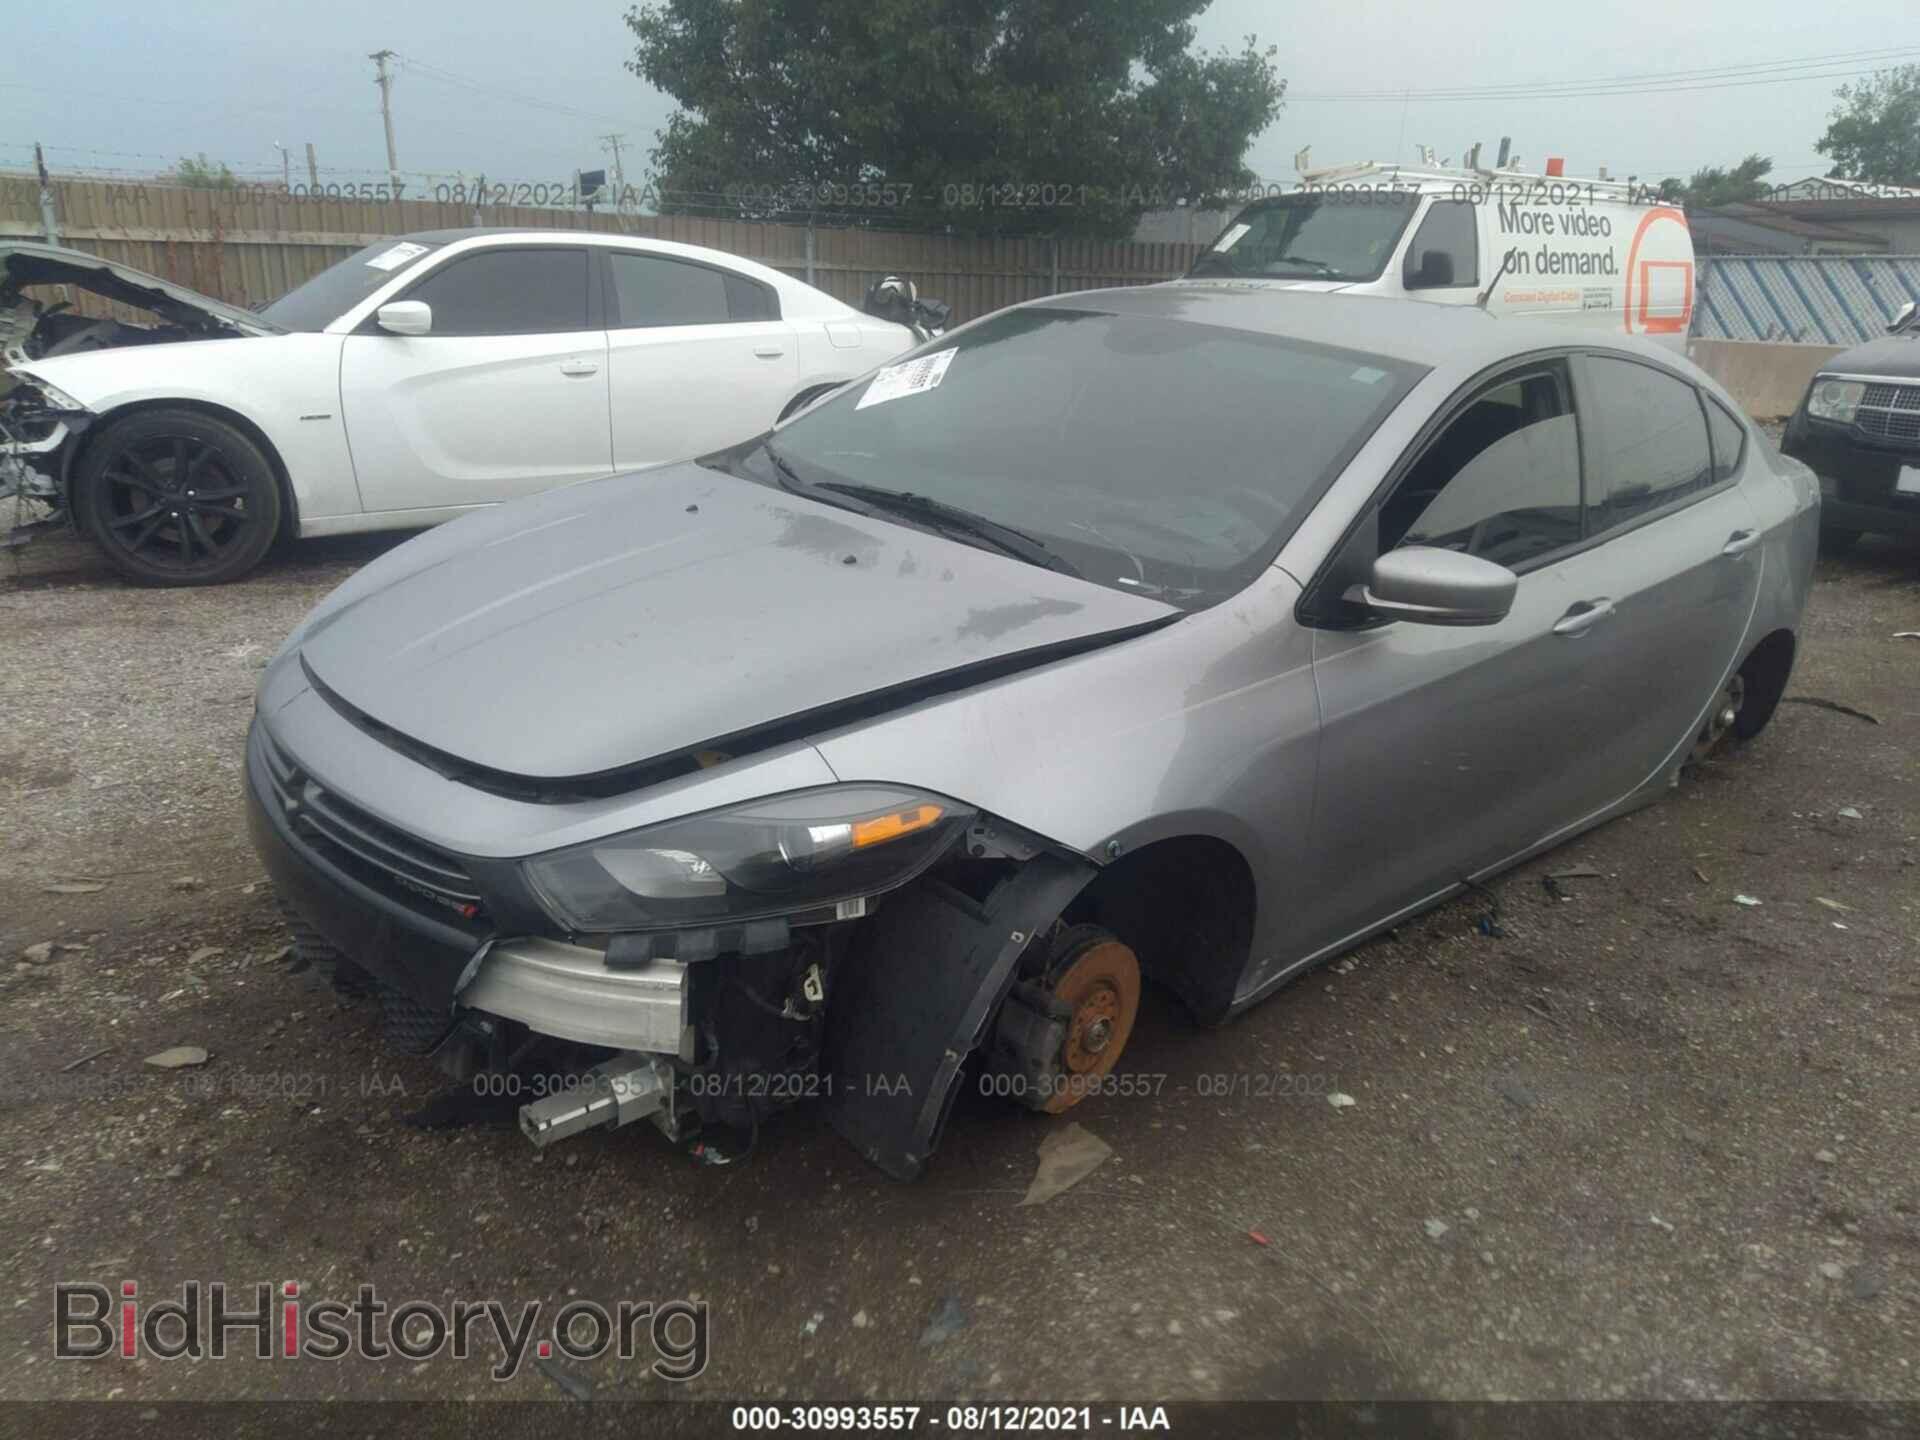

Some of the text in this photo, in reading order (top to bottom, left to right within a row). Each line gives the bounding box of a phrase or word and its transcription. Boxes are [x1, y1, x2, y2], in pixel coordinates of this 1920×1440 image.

[1497, 202, 1612, 237] More video
[1503, 243, 1619, 275] on demand.
